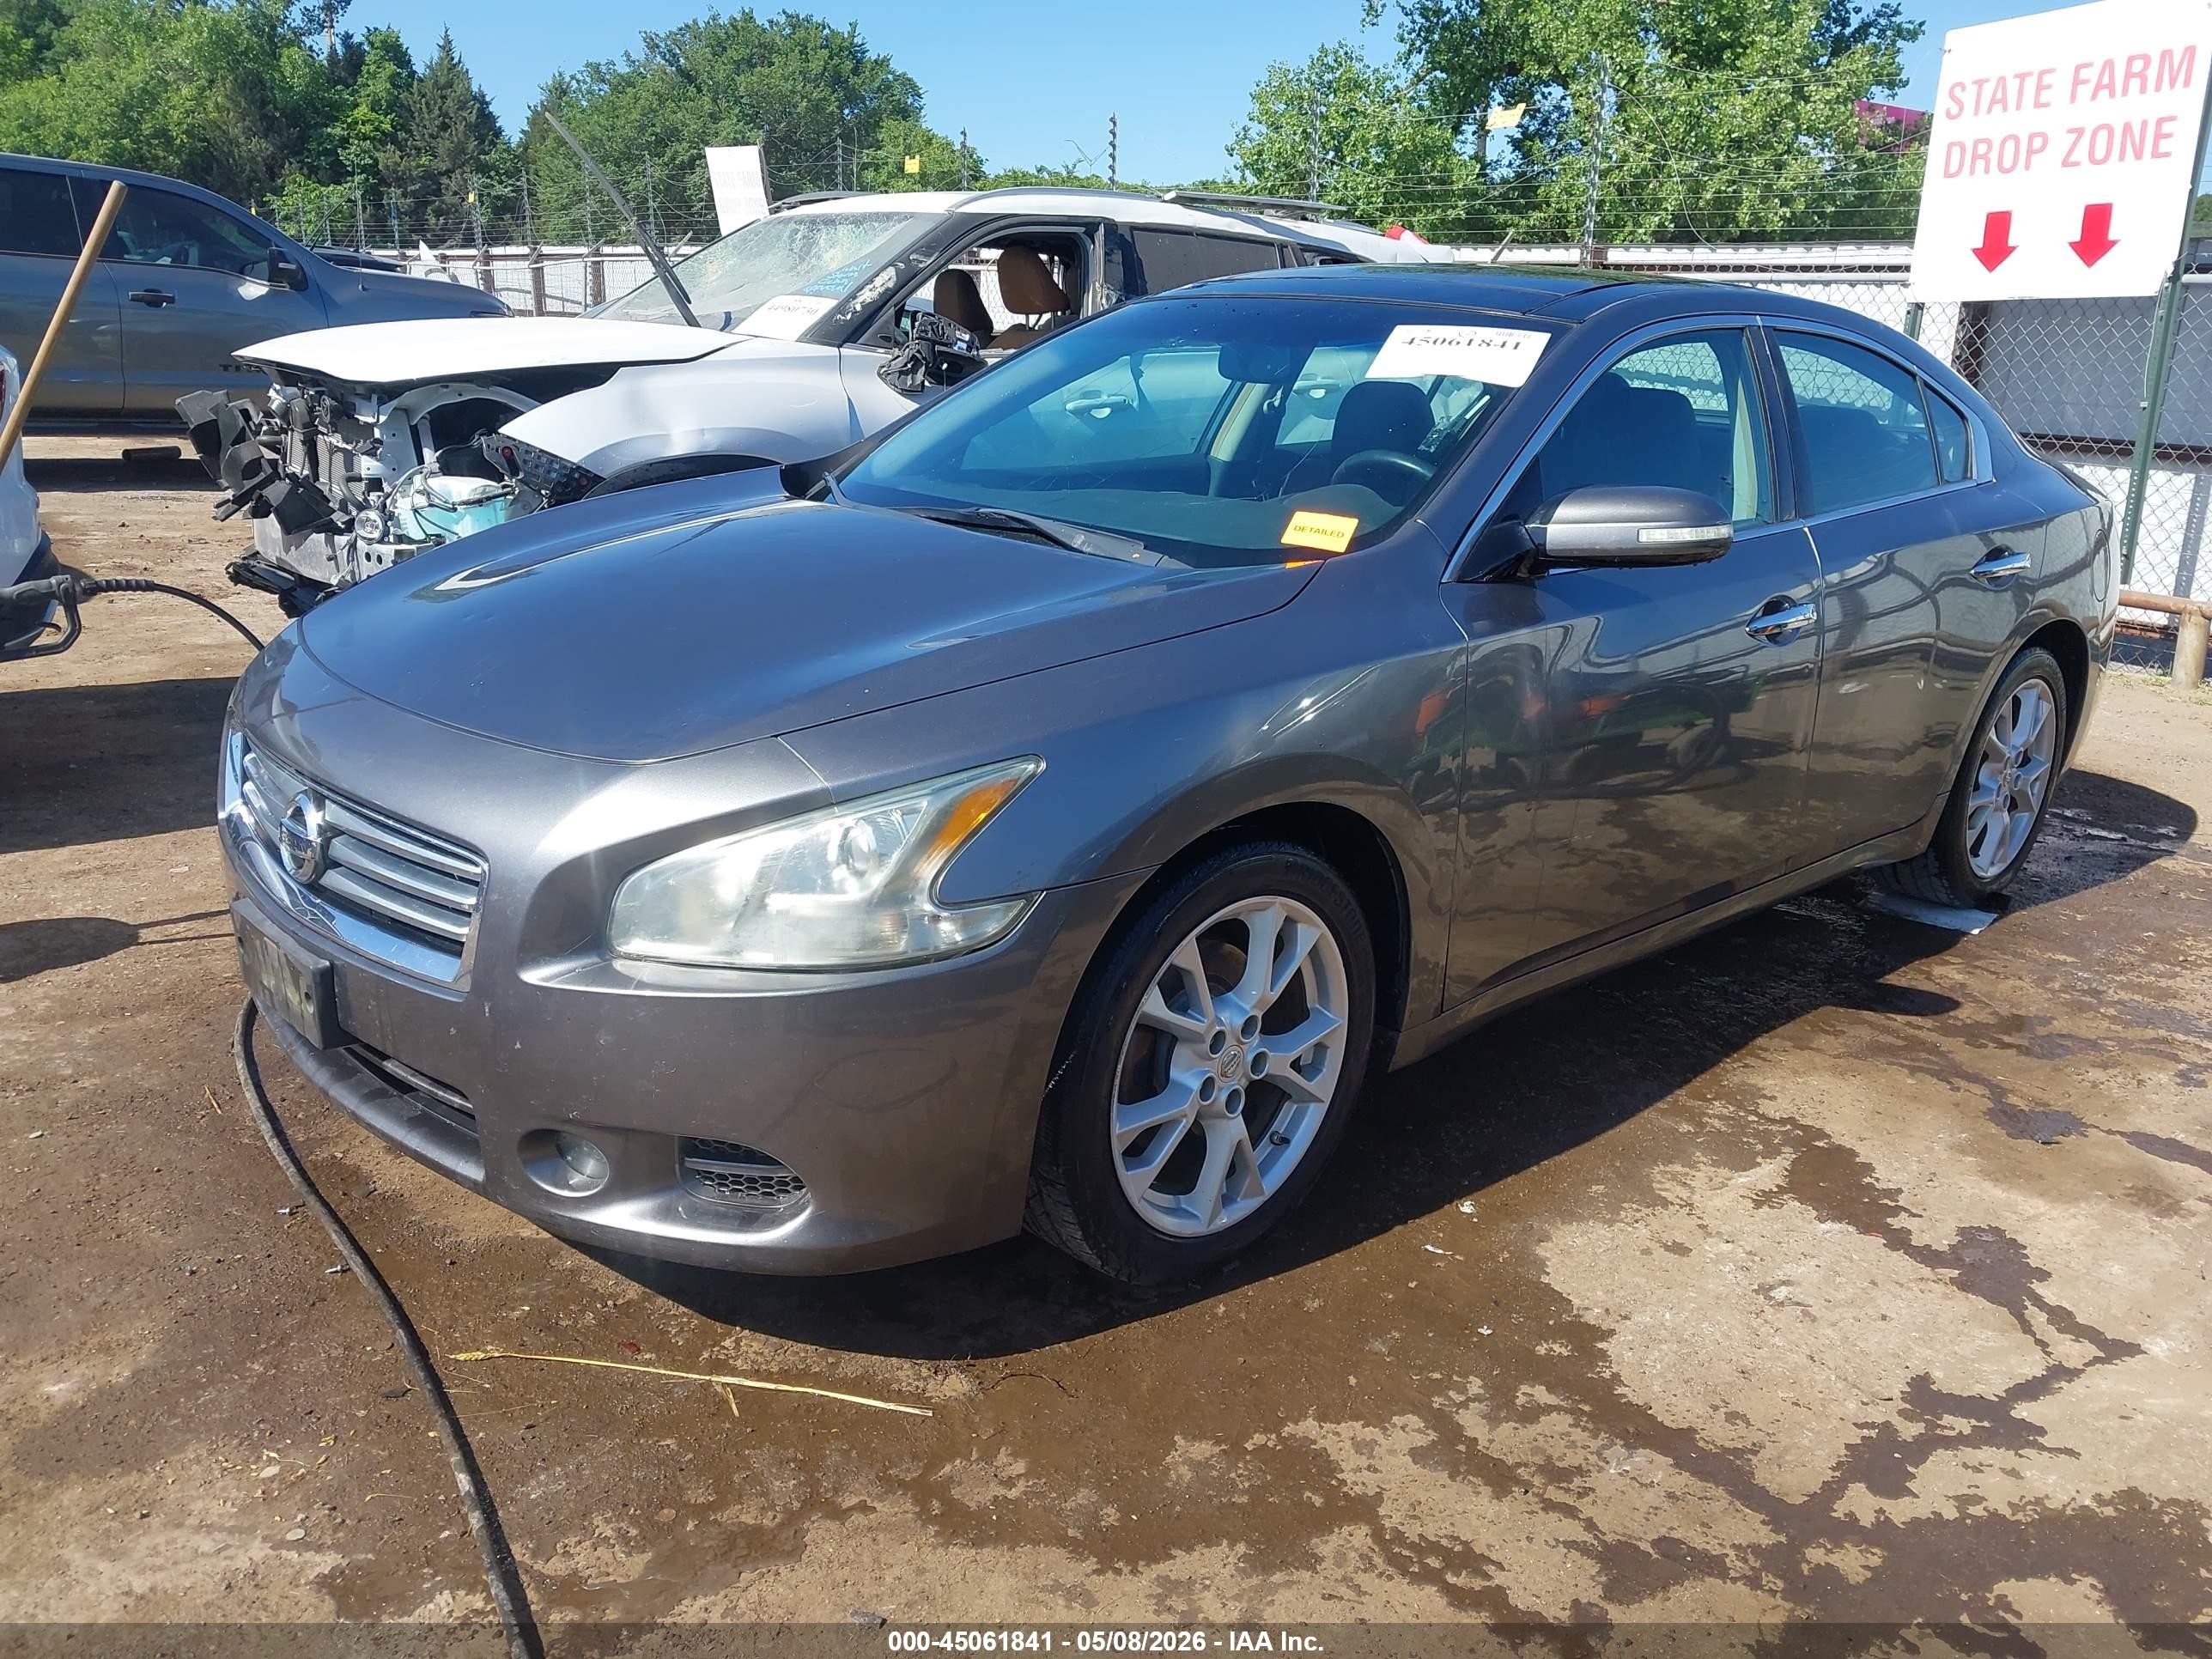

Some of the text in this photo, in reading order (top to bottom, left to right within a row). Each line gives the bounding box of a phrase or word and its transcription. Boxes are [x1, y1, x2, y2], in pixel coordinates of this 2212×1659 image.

[1944, 44, 2197, 121] STATE FARM
[1942, 114, 2179, 179] DROP ZONE
[1401, 336, 1522, 351] 45061841
[1293, 525, 1345, 538] DETAILED
